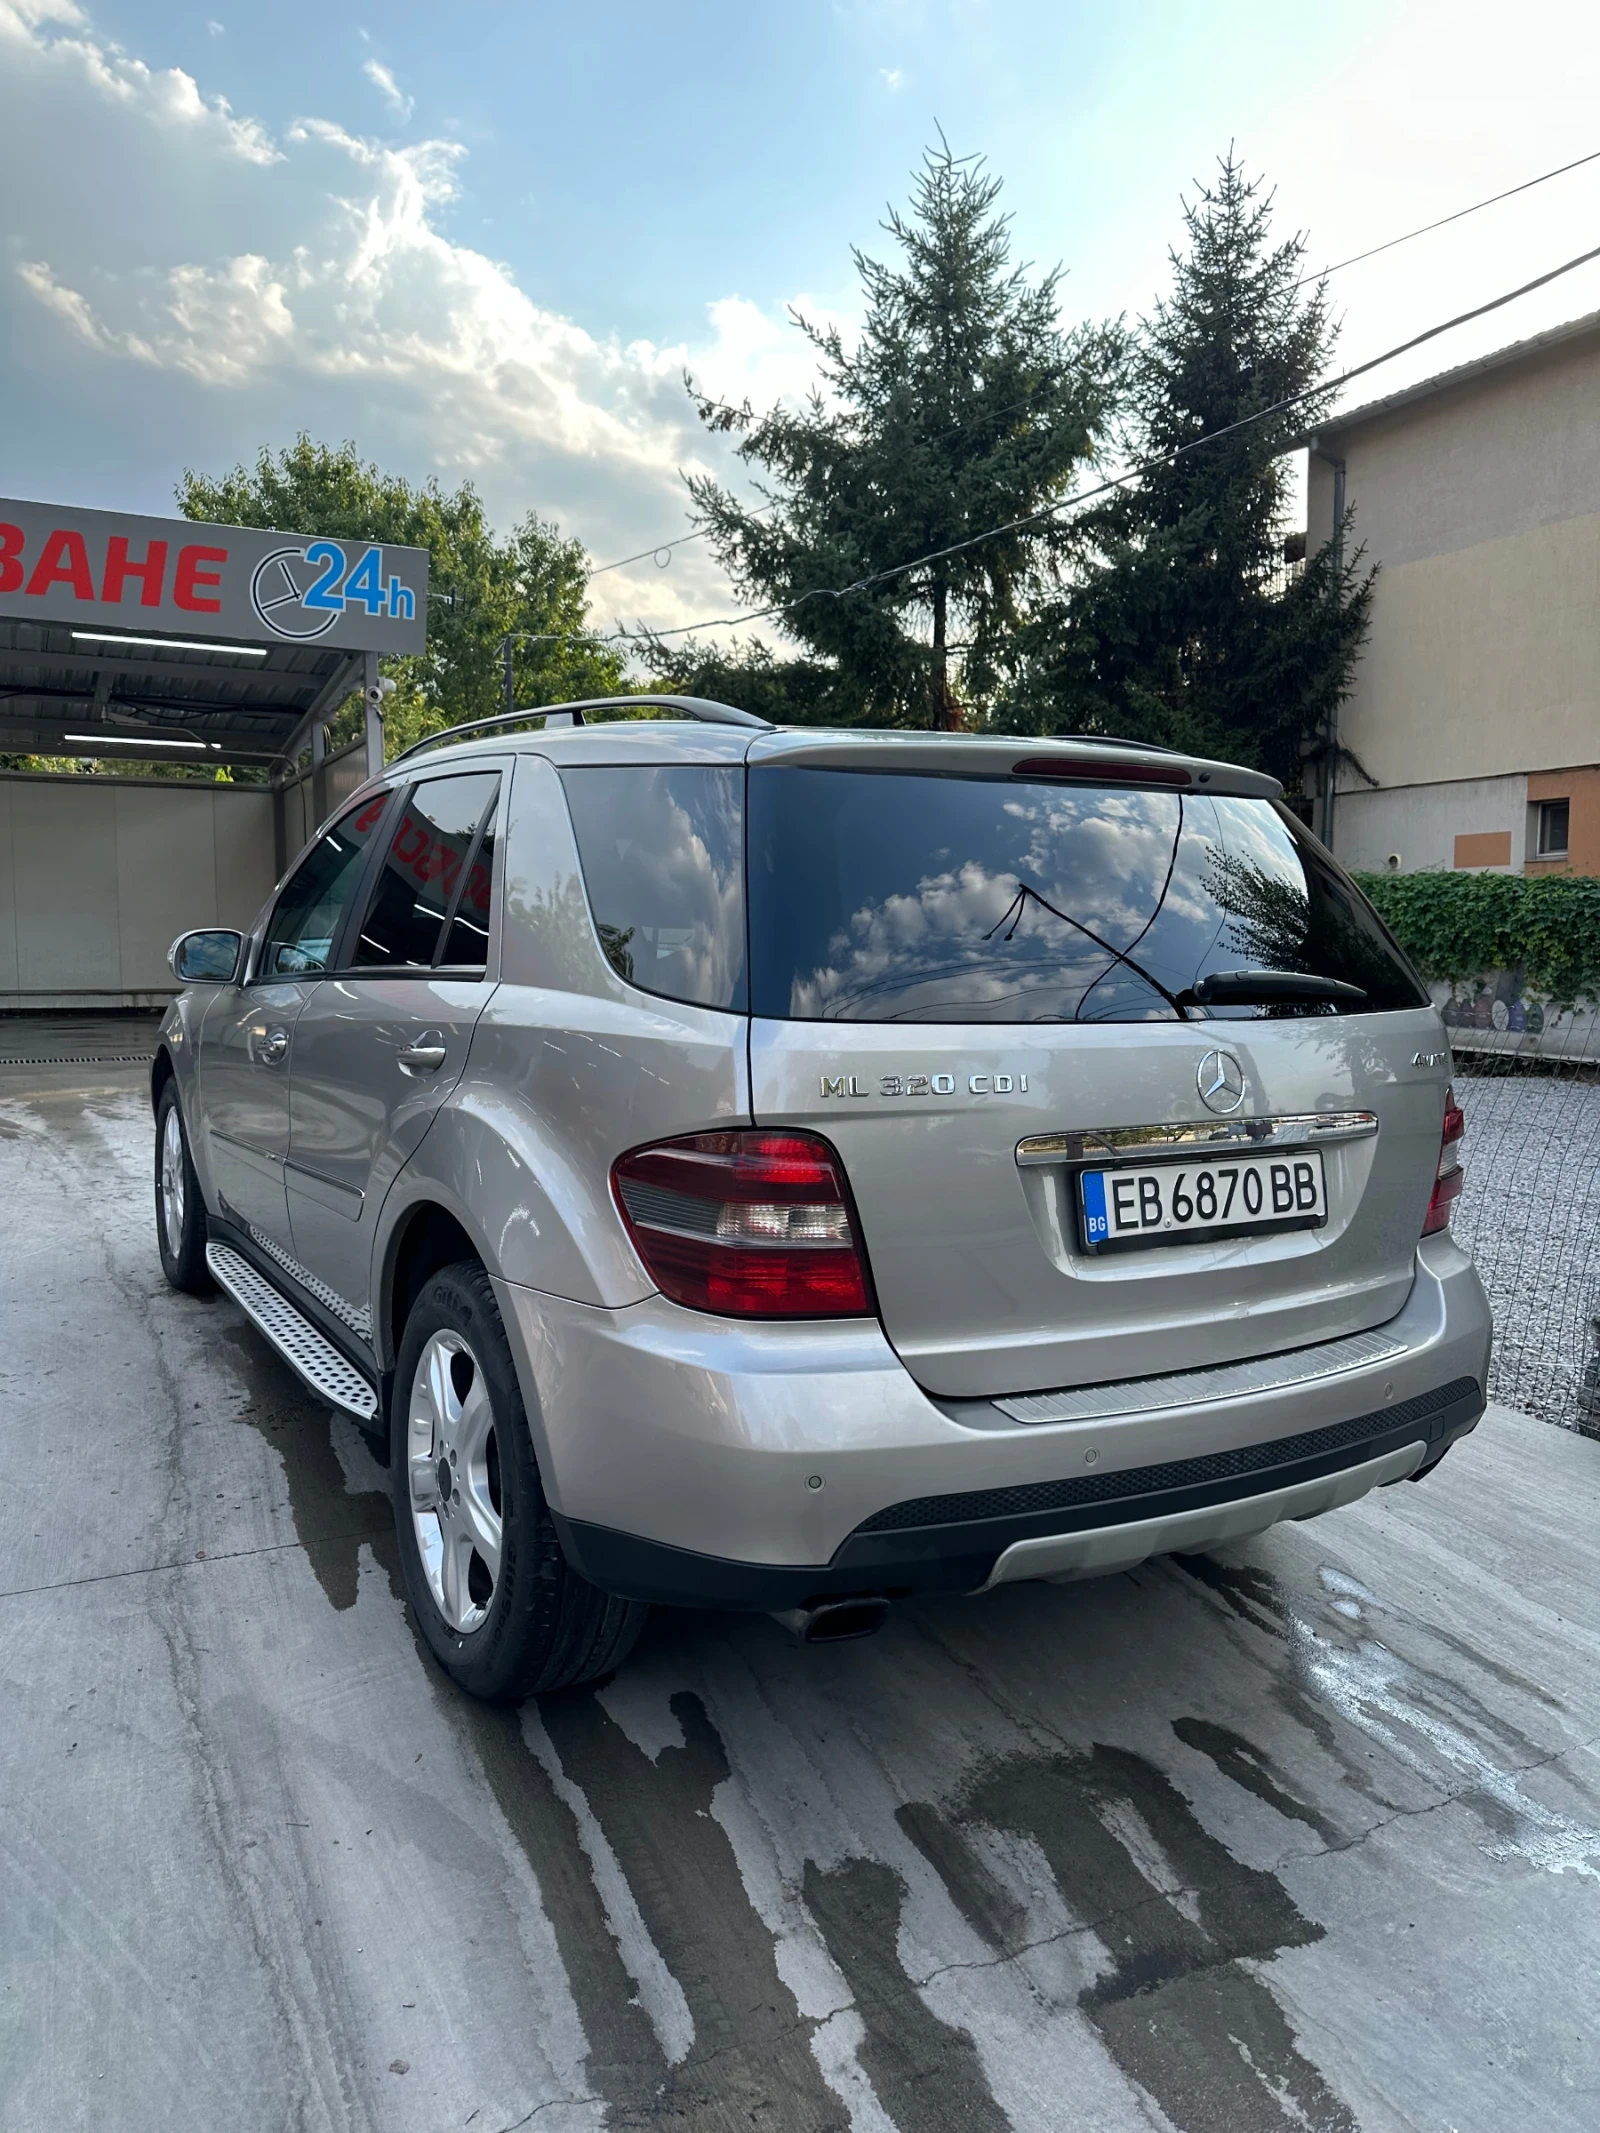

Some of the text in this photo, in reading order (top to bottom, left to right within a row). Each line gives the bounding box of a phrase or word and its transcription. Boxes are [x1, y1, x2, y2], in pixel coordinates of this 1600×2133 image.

[302, 541, 416, 620] 24h
[820, 1074, 1029, 1098] ML 320 CDI
[1172, 1167, 1263, 1223] 6870
[1270, 1162, 1317, 1214] BB
[1088, 1217, 1106, 1233] BG
